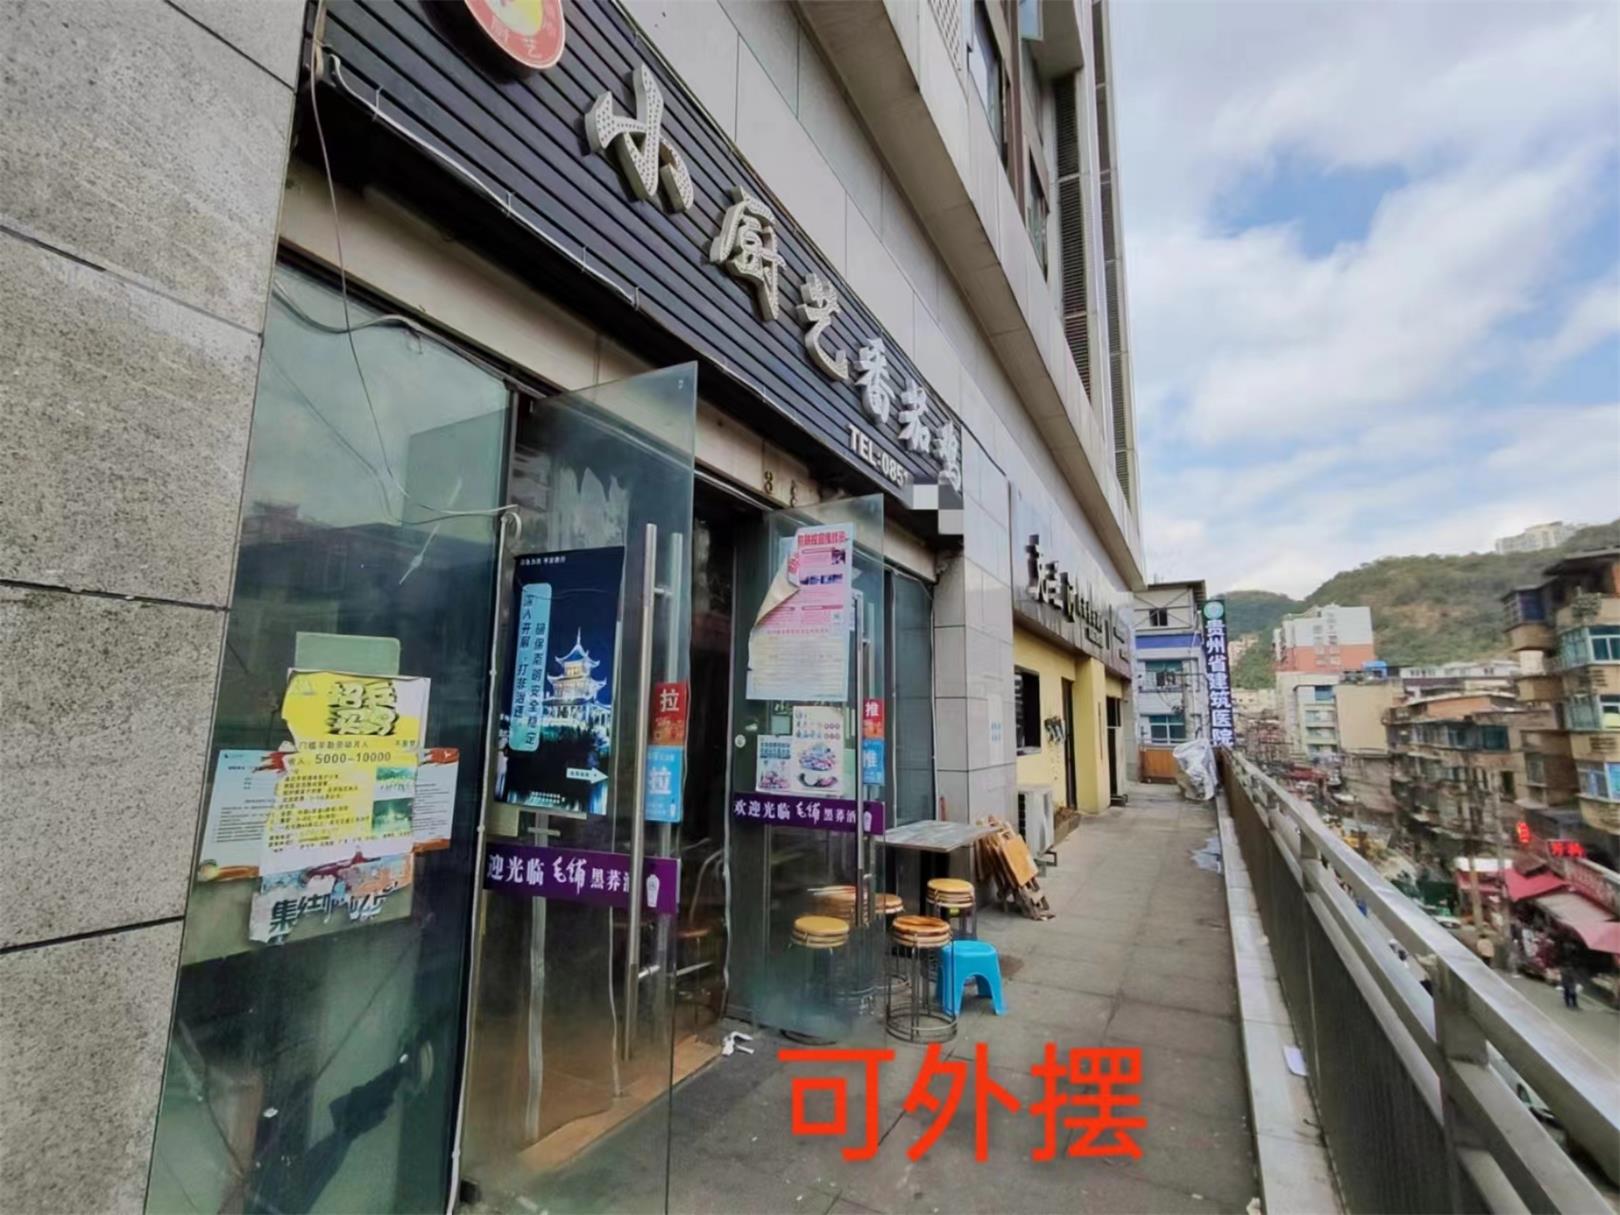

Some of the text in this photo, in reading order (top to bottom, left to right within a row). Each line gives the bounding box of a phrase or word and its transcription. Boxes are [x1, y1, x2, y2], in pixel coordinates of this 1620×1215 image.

[1205, 618, 1235, 746] 贵州省建筑医院
[660, 688, 680, 712] 拉
[865, 701, 880, 718] 推
[315, 752, 391, 764] 5000-10000
[650, 766, 671, 795] 拉
[734, 800, 790, 820] 欢迎光临
[487, 854, 545, 886] 迎光临
